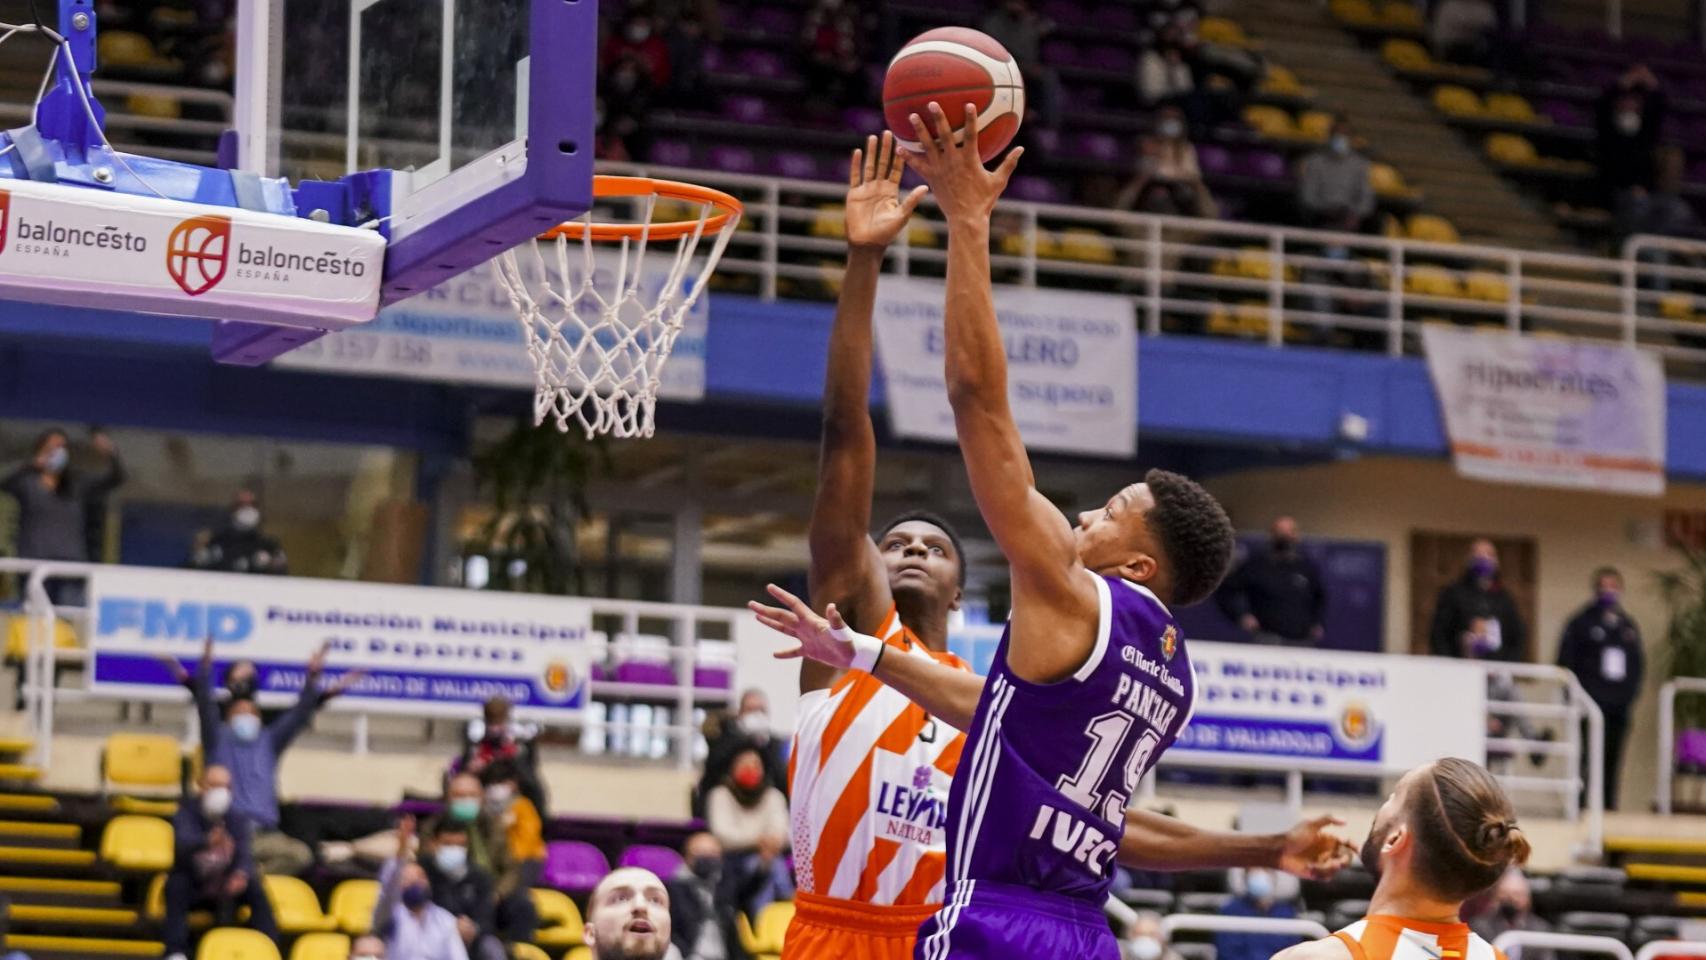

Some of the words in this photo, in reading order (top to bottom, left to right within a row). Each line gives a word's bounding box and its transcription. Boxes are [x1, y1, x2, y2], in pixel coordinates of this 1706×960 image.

[16, 243, 70, 257] ESPAÑA
[236, 268, 289, 282] ESPAÑA
[99, 597, 253, 642] FMD
[433, 617, 586, 643] Municipal
[368, 638, 524, 661] Deportes
[1222, 661, 1385, 687] Municipal
[1206, 685, 1324, 707] portes
[885, 819, 932, 846] NATURA
[1029, 804, 1118, 878] IVEC
